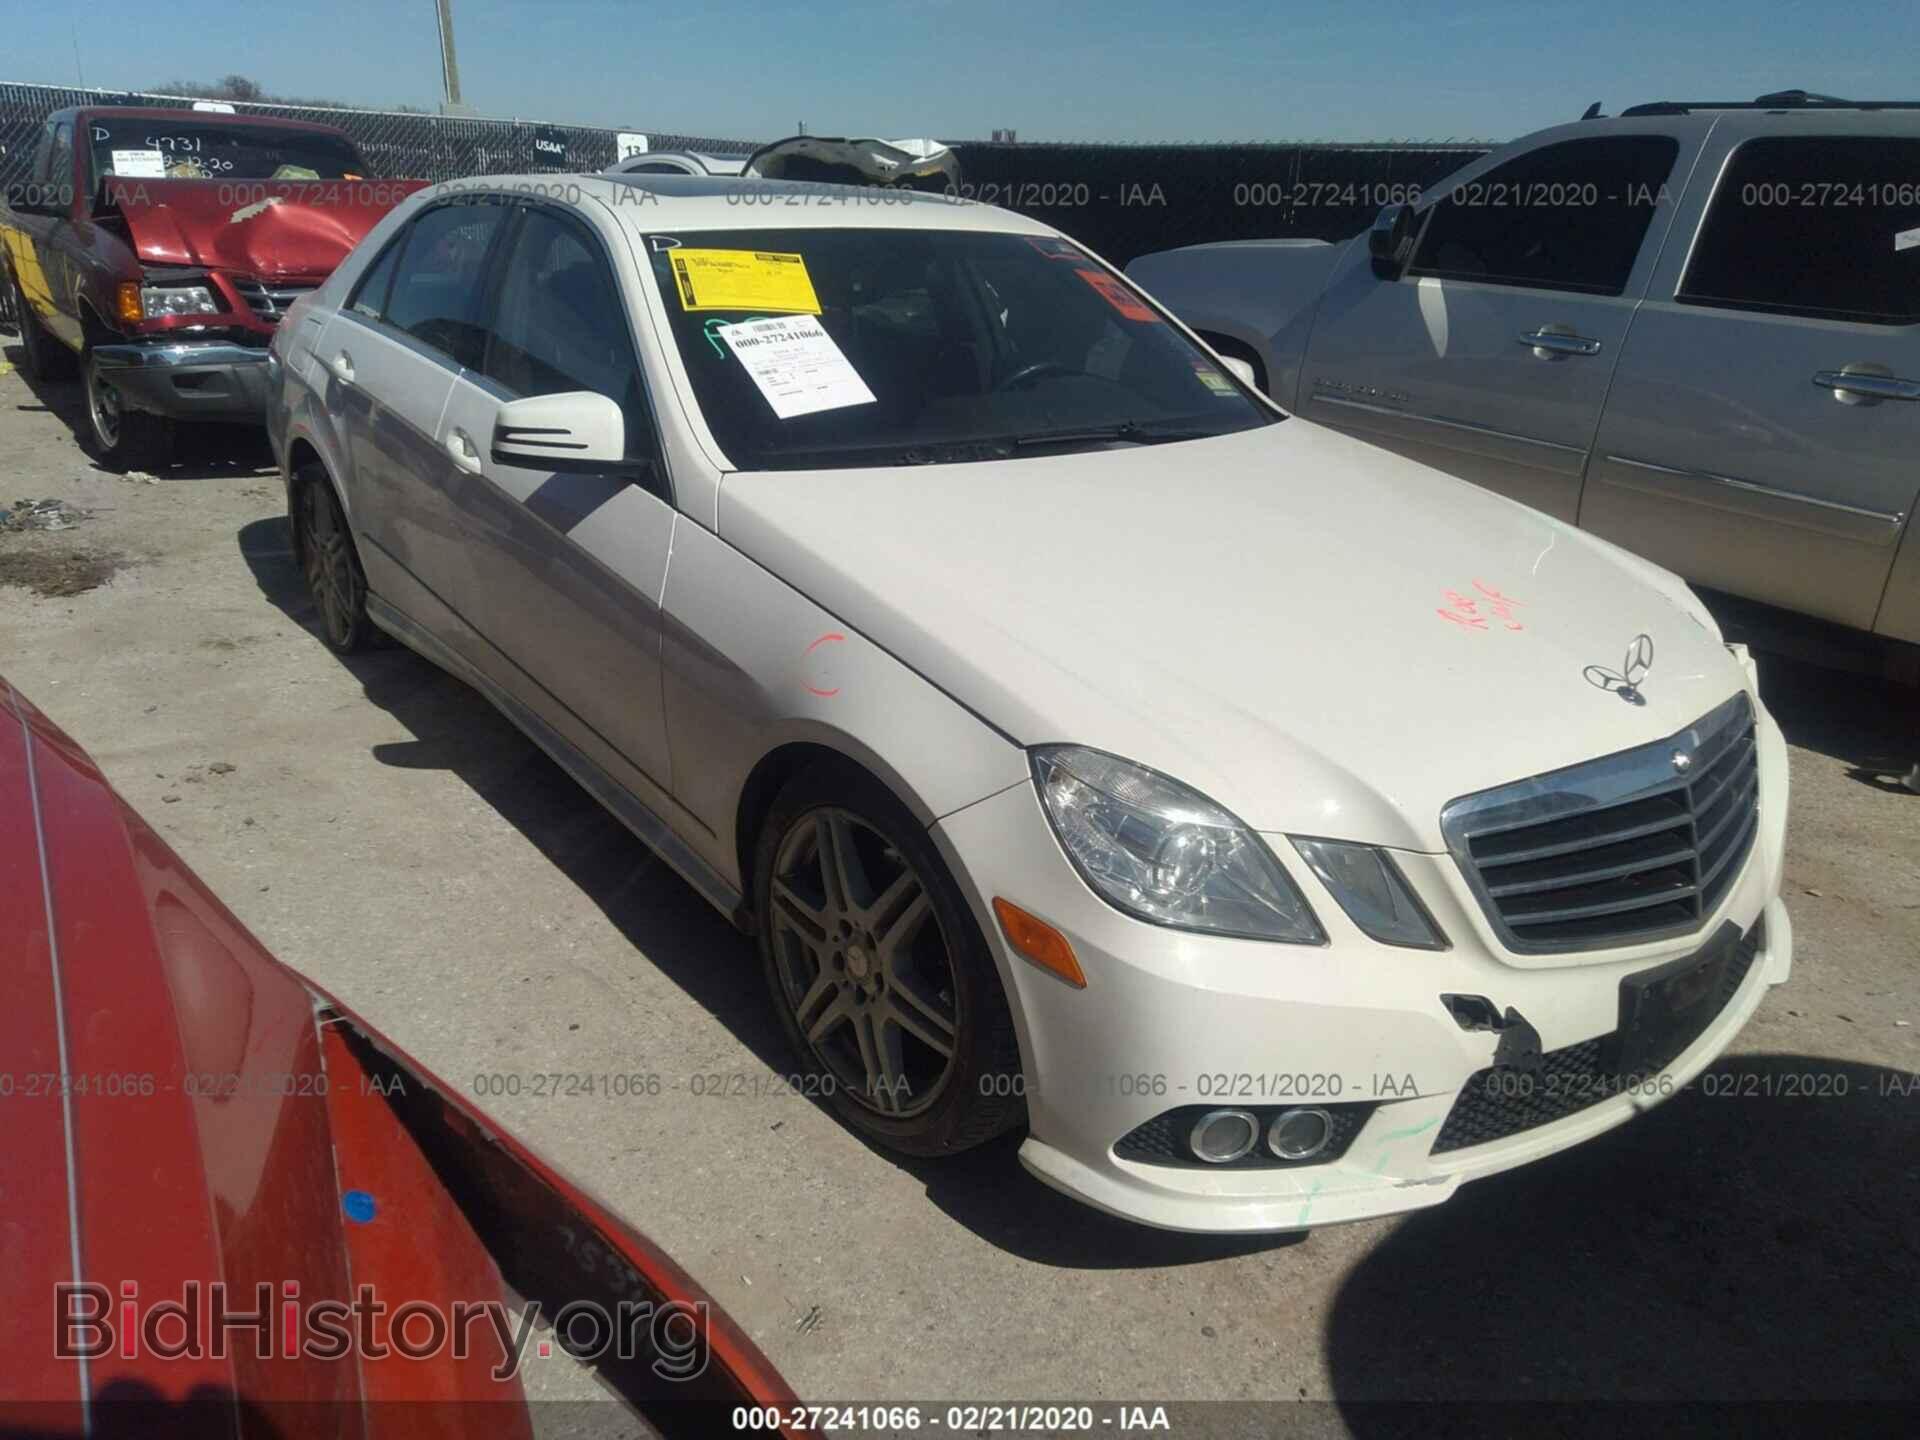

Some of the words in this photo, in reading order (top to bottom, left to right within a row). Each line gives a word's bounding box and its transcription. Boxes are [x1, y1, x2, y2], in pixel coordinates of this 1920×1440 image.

[145, 136, 201, 152] 4731
[625, 145, 641, 158] 13
[735, 330, 824, 350] 000-27241066
